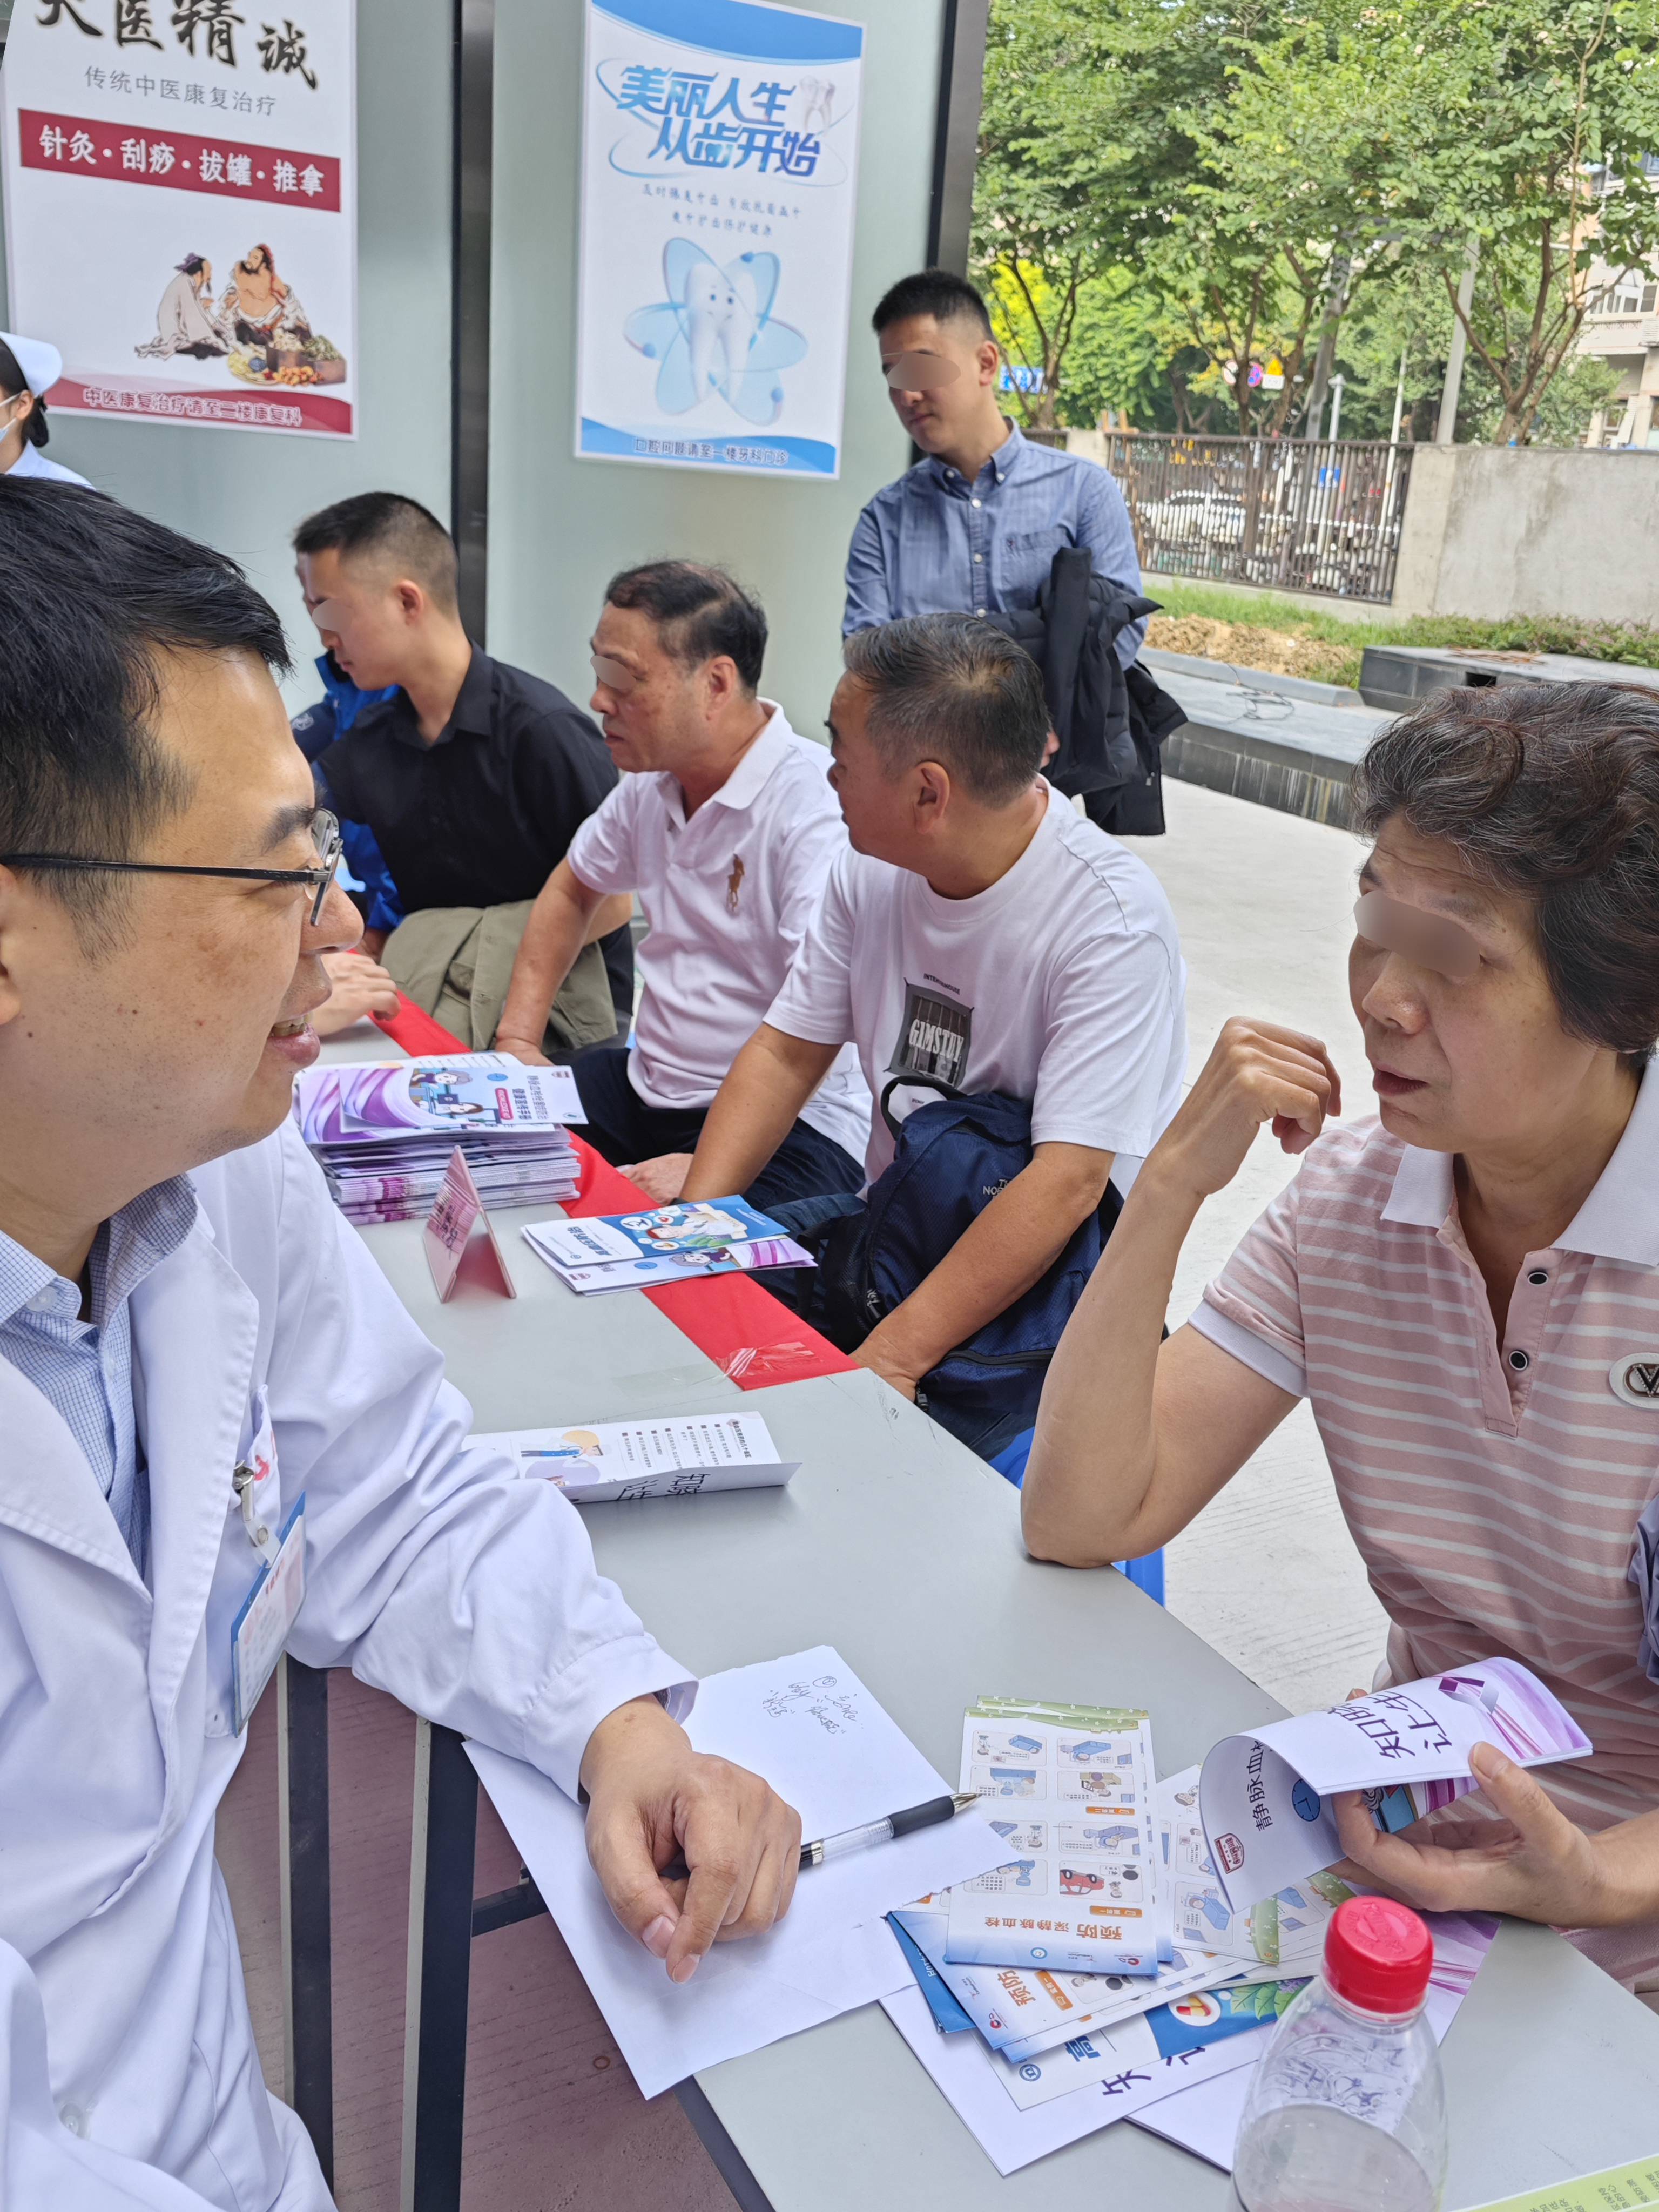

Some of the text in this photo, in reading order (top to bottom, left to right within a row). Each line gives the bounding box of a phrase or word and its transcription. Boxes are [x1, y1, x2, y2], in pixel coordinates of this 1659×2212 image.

[85, 65, 276, 116] 传统中医康复治疗
[617, 65, 797, 127] 美丽人生
[647, 117, 820, 177] 从齿开始
[983, 1185, 1004, 1195] NOR
[984, 1917, 1122, 1940] 预防 深静脉血栓
[996, 1969, 1036, 2007] 预防
